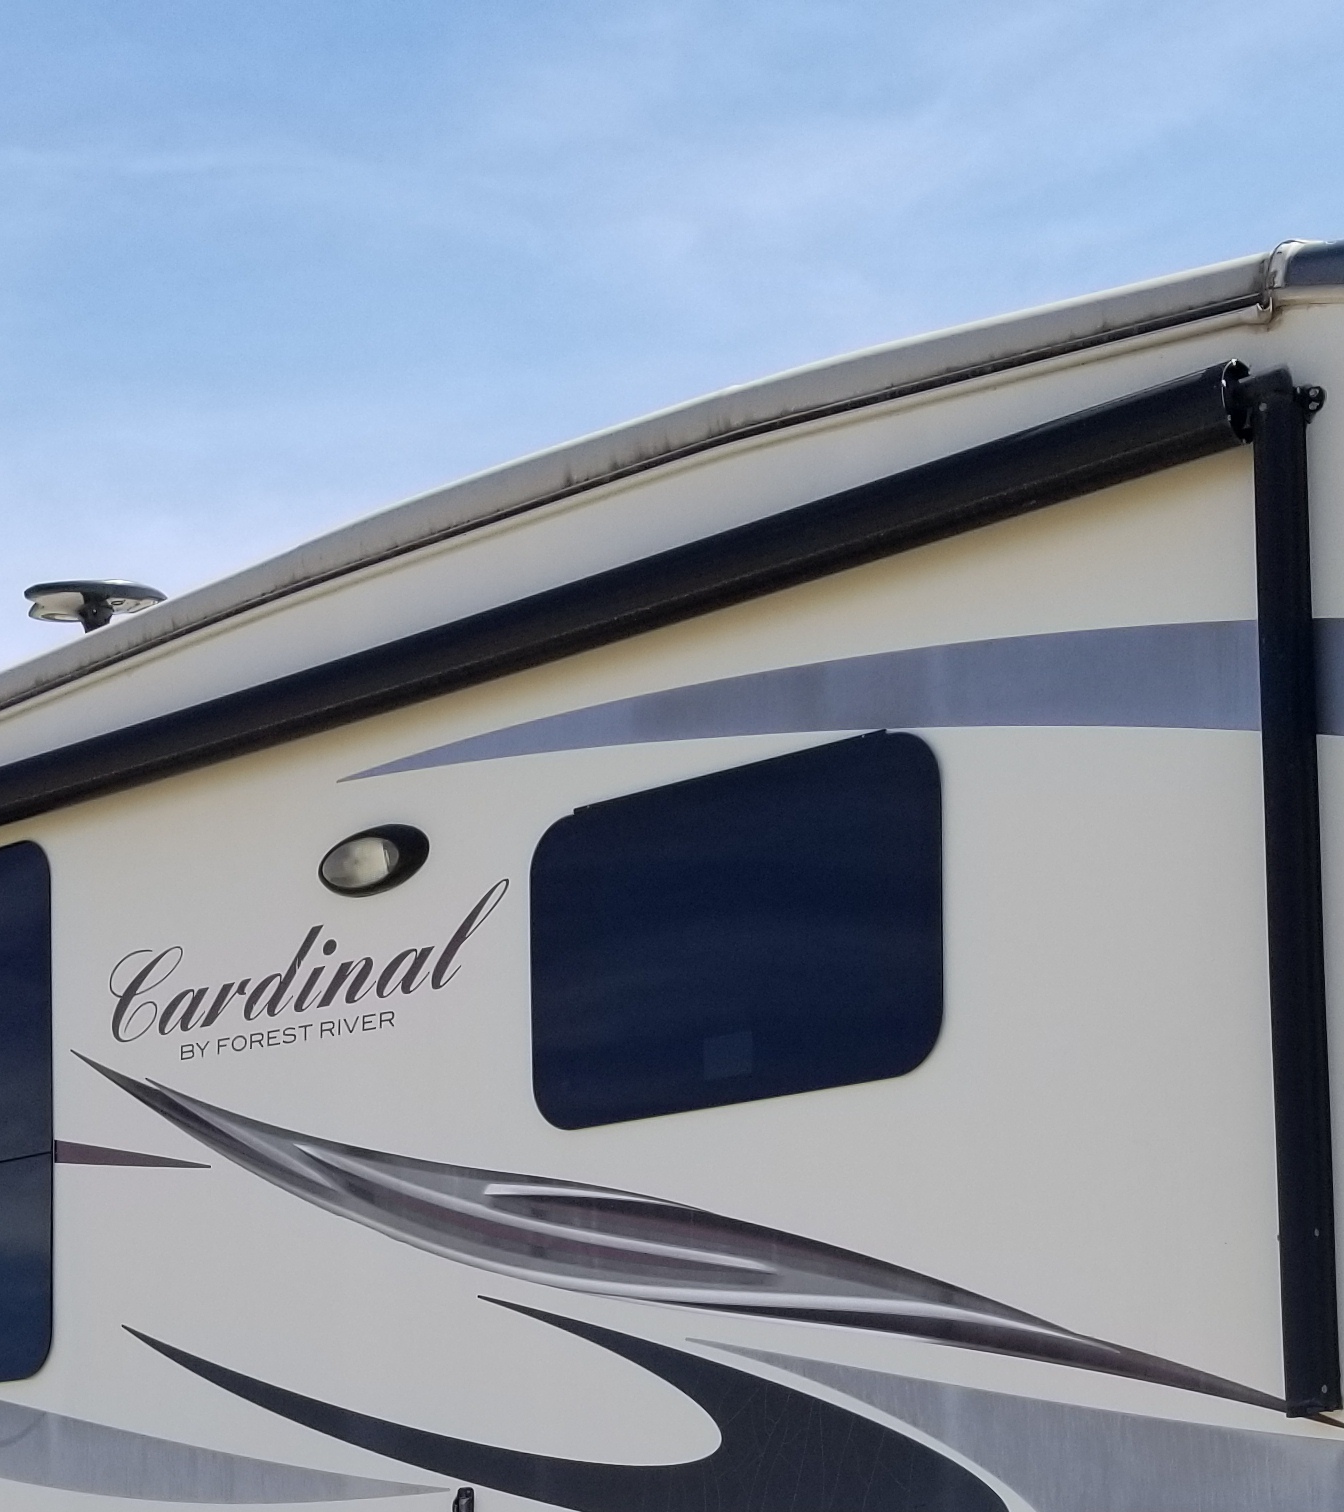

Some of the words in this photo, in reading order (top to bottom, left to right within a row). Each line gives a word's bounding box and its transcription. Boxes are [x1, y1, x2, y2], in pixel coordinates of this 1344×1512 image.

[109, 878, 510, 1043] Cardinal
[179, 1040, 210, 1061] BY
[216, 1024, 313, 1056] FOREST
[320, 1010, 395, 1039] RIVER
